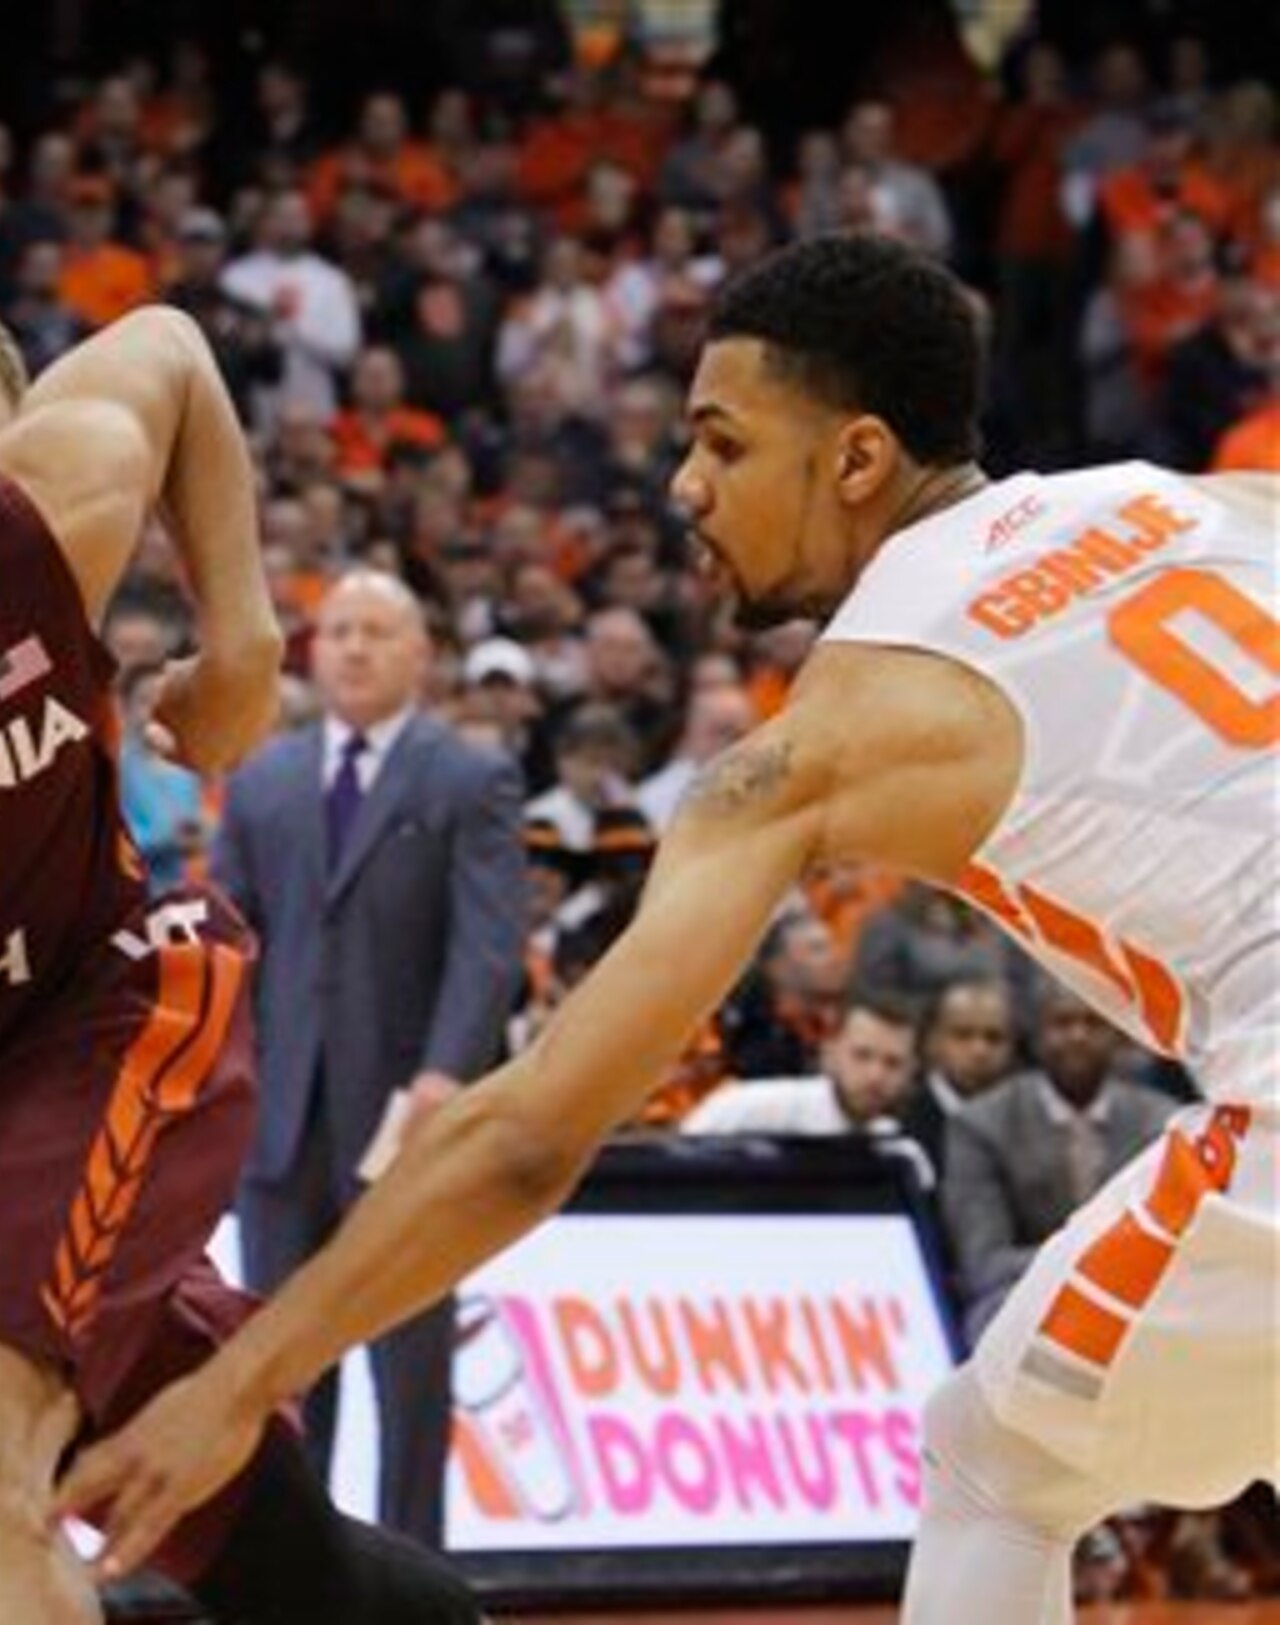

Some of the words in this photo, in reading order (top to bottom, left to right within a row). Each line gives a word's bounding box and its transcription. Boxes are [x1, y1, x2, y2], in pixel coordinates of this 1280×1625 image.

[986, 495, 1042, 552] ACC
[1107, 567, 1280, 748] 0
[554, 1296, 904, 1396] DUNKIN'
[588, 1411, 921, 1516] DONUTS
